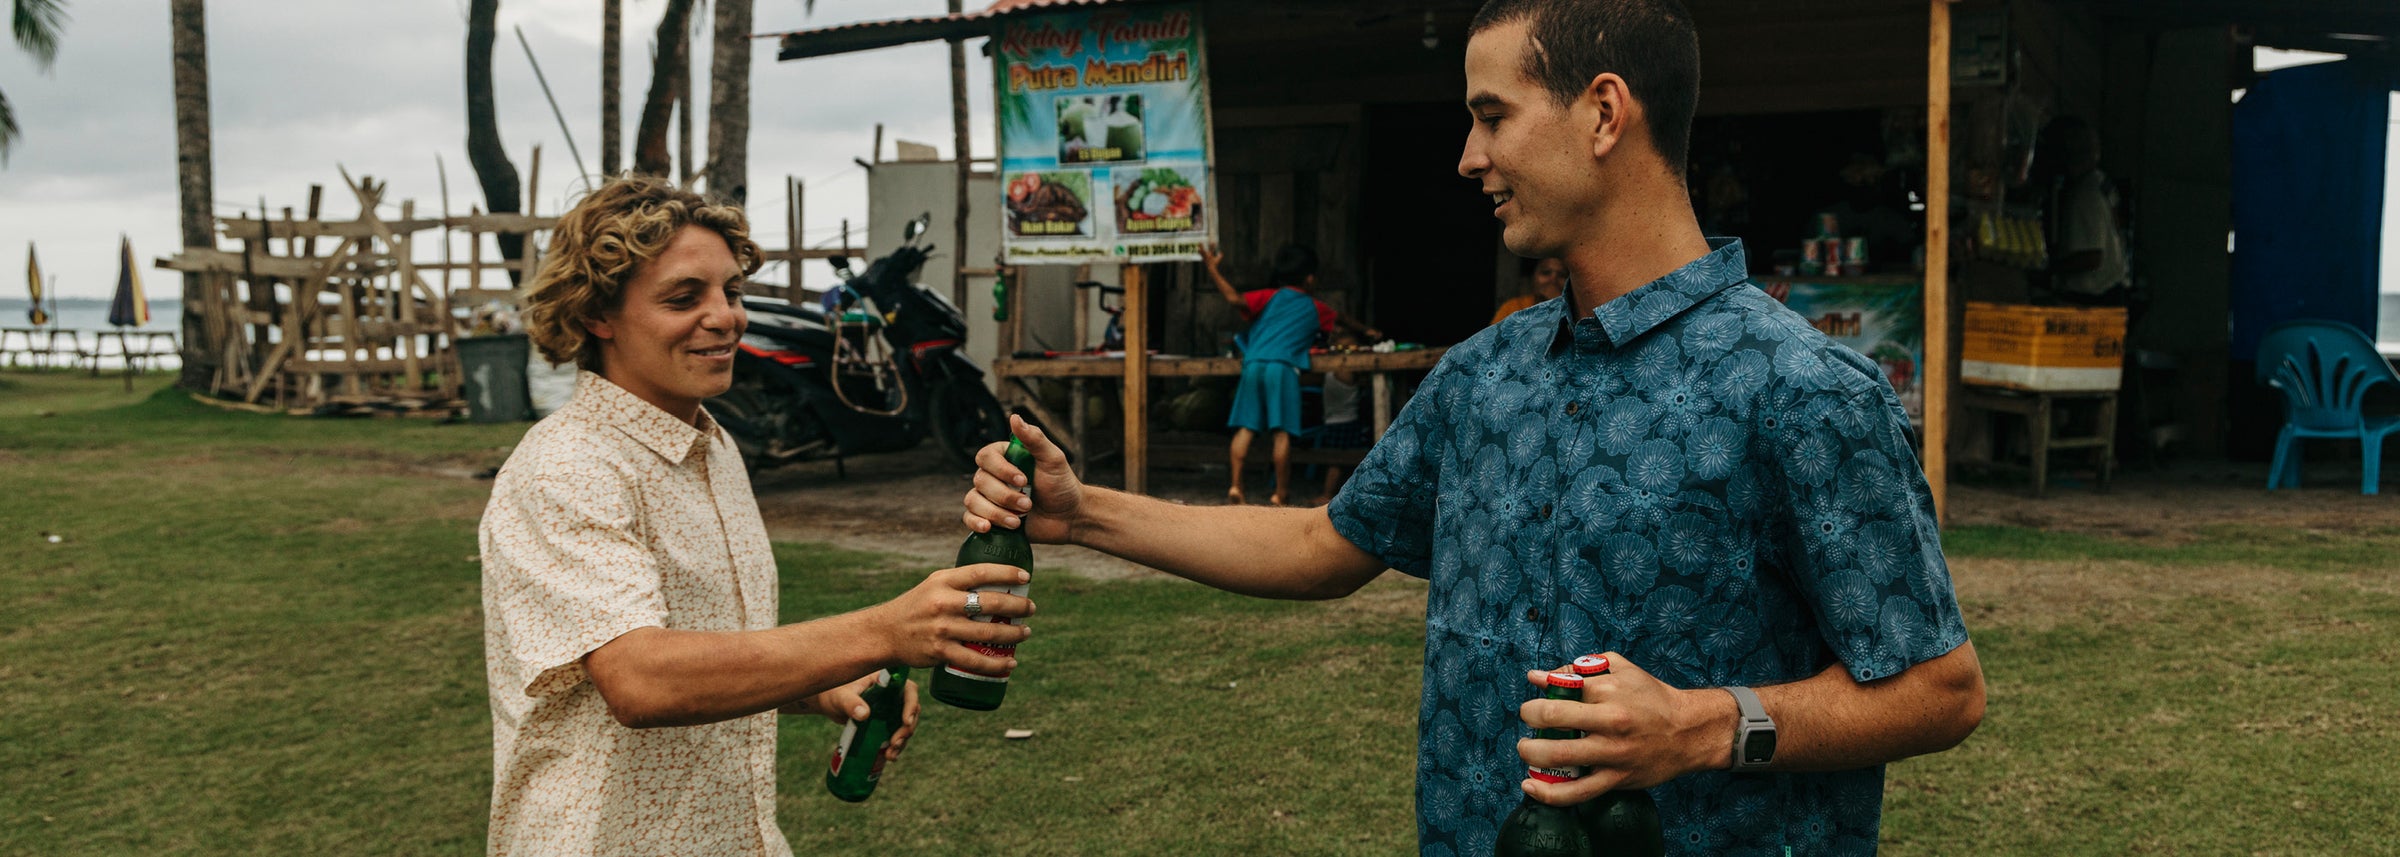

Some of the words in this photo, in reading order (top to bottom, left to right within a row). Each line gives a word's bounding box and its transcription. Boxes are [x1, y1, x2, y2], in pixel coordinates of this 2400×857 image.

[1009, 63, 1078, 92] Putra
[1084, 52, 1188, 86] Mandiri
[1020, 220, 1043, 234] Ikan
[1045, 219, 1076, 234] Bakar
[1125, 217, 1154, 232] Ayam
